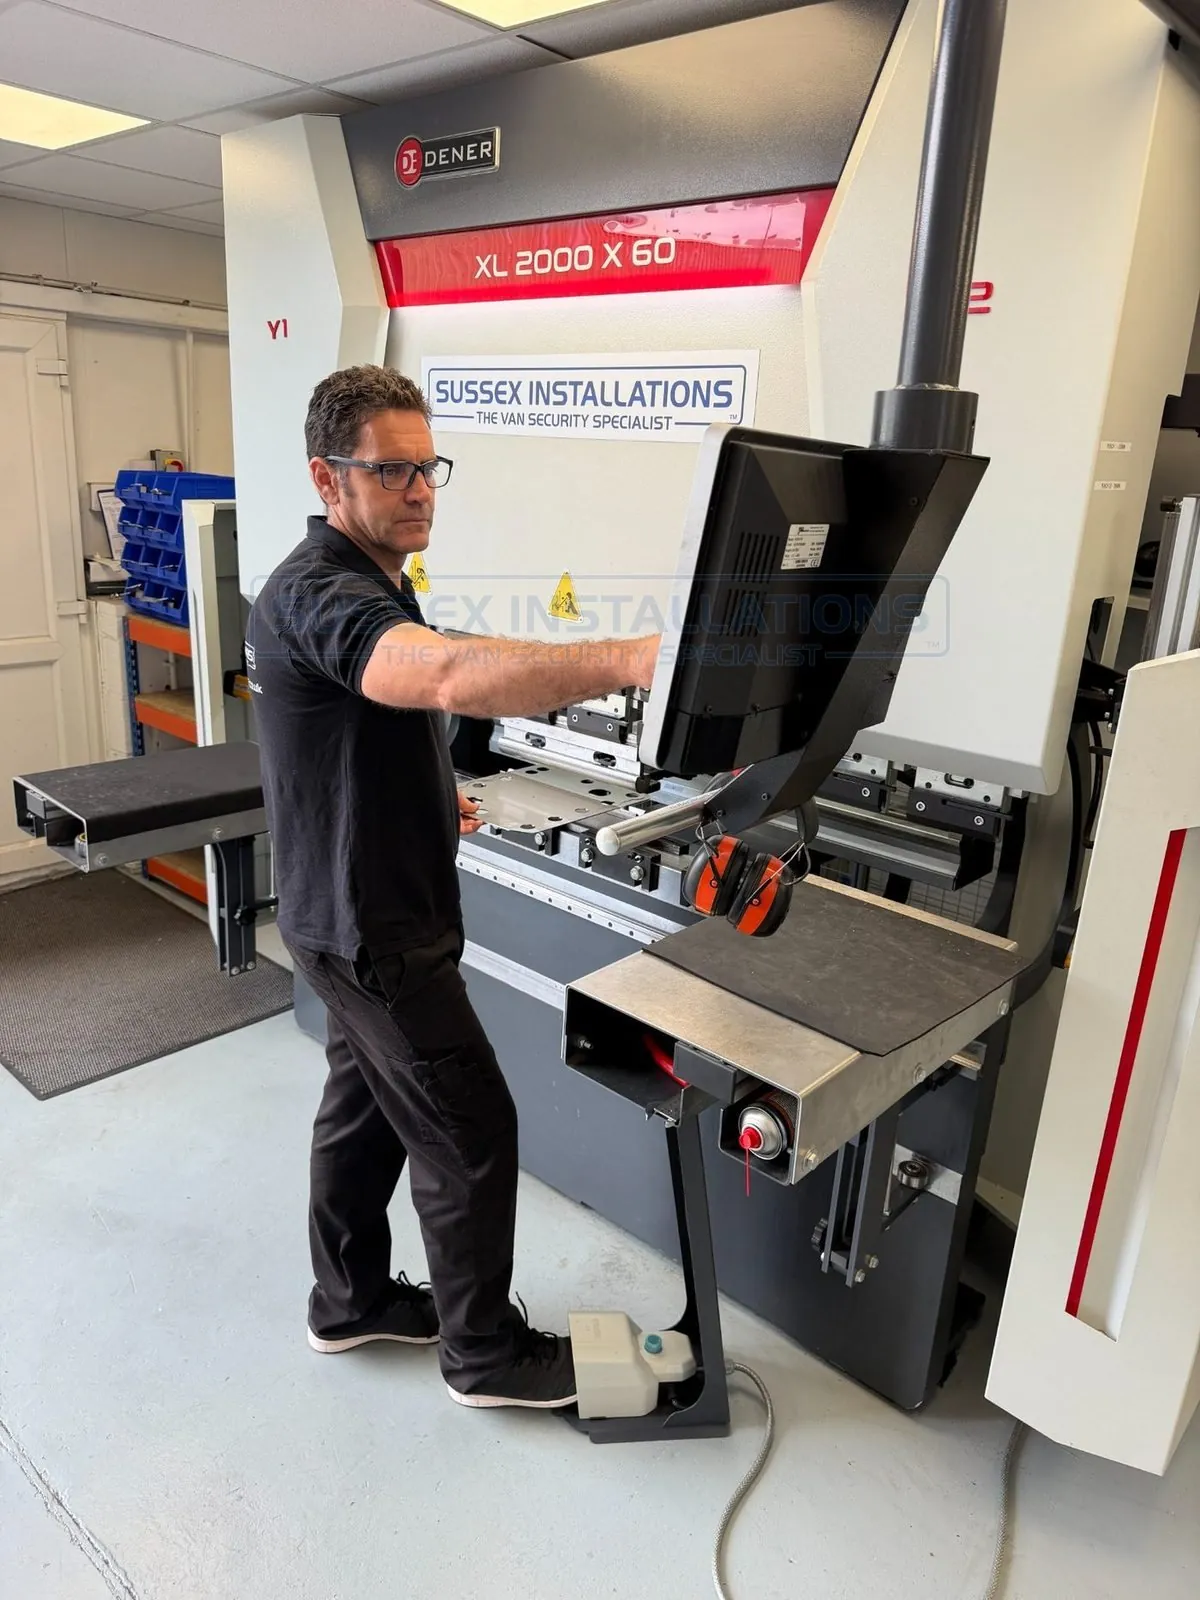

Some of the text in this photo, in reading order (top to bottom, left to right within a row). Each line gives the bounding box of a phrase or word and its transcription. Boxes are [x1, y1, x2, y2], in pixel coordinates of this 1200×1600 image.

[424, 141, 492, 168] DENER
[474, 236, 676, 279] XL 2000 X 60
[967, 281, 994, 315] 2
[266, 318, 288, 340] Y1
[435, 379, 733, 408] SUSSEX INSTALLATIONS
[476, 411, 673, 430] THE VAN SECURITY SPECIALIST
